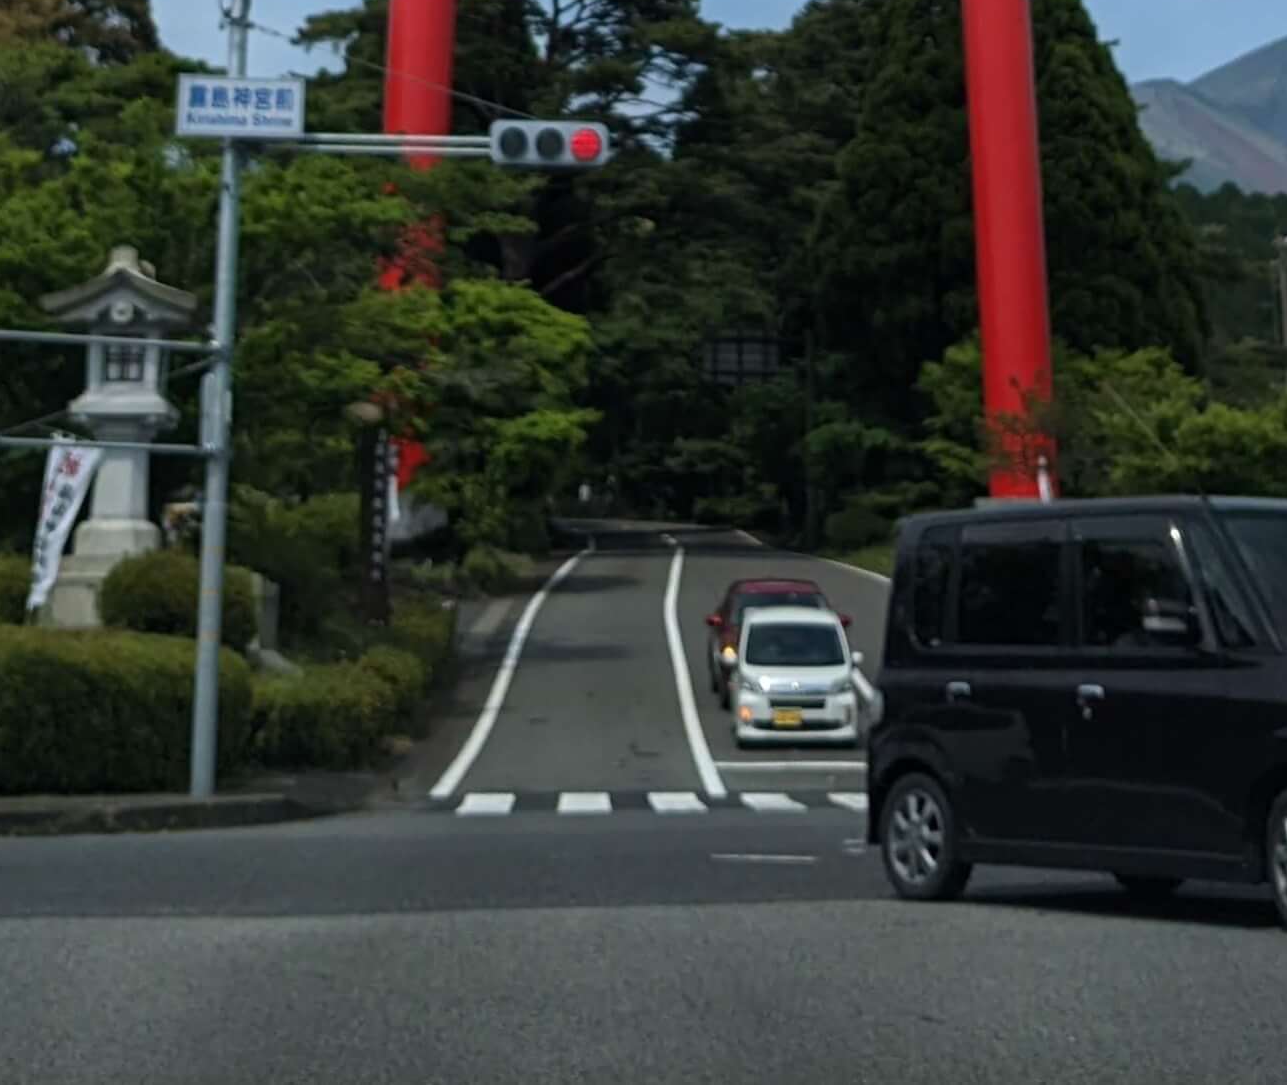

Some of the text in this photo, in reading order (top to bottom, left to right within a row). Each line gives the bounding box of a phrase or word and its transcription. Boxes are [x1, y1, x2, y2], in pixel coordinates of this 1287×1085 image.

[189, 84, 293, 110] 霧島神宮前
[186, 112, 247, 126] Kirishima
